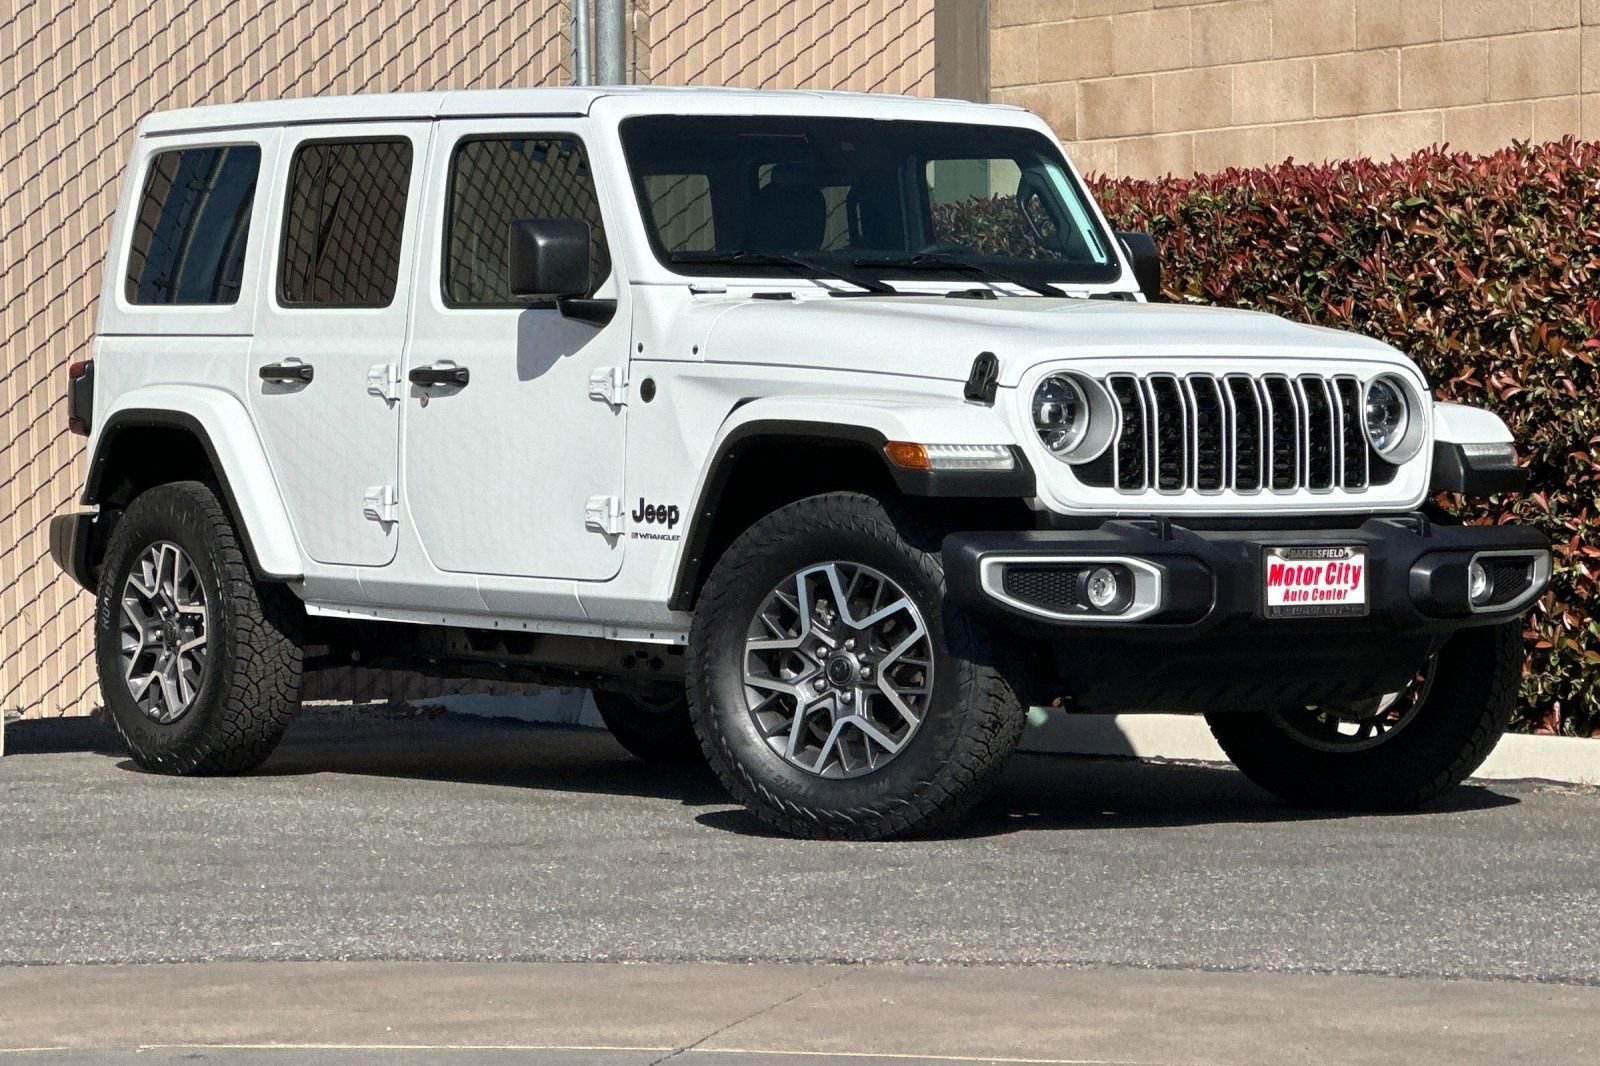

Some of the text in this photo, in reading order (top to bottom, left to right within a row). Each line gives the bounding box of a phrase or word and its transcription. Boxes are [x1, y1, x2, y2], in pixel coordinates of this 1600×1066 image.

[632, 497, 680, 530] Jeep
[639, 532, 681, 541] WRANGLER
[1291, 549, 1344, 559] BAKERSFIELD
[1266, 562, 1362, 590] Motor City
[1283, 588, 1348, 602] Auto Center
